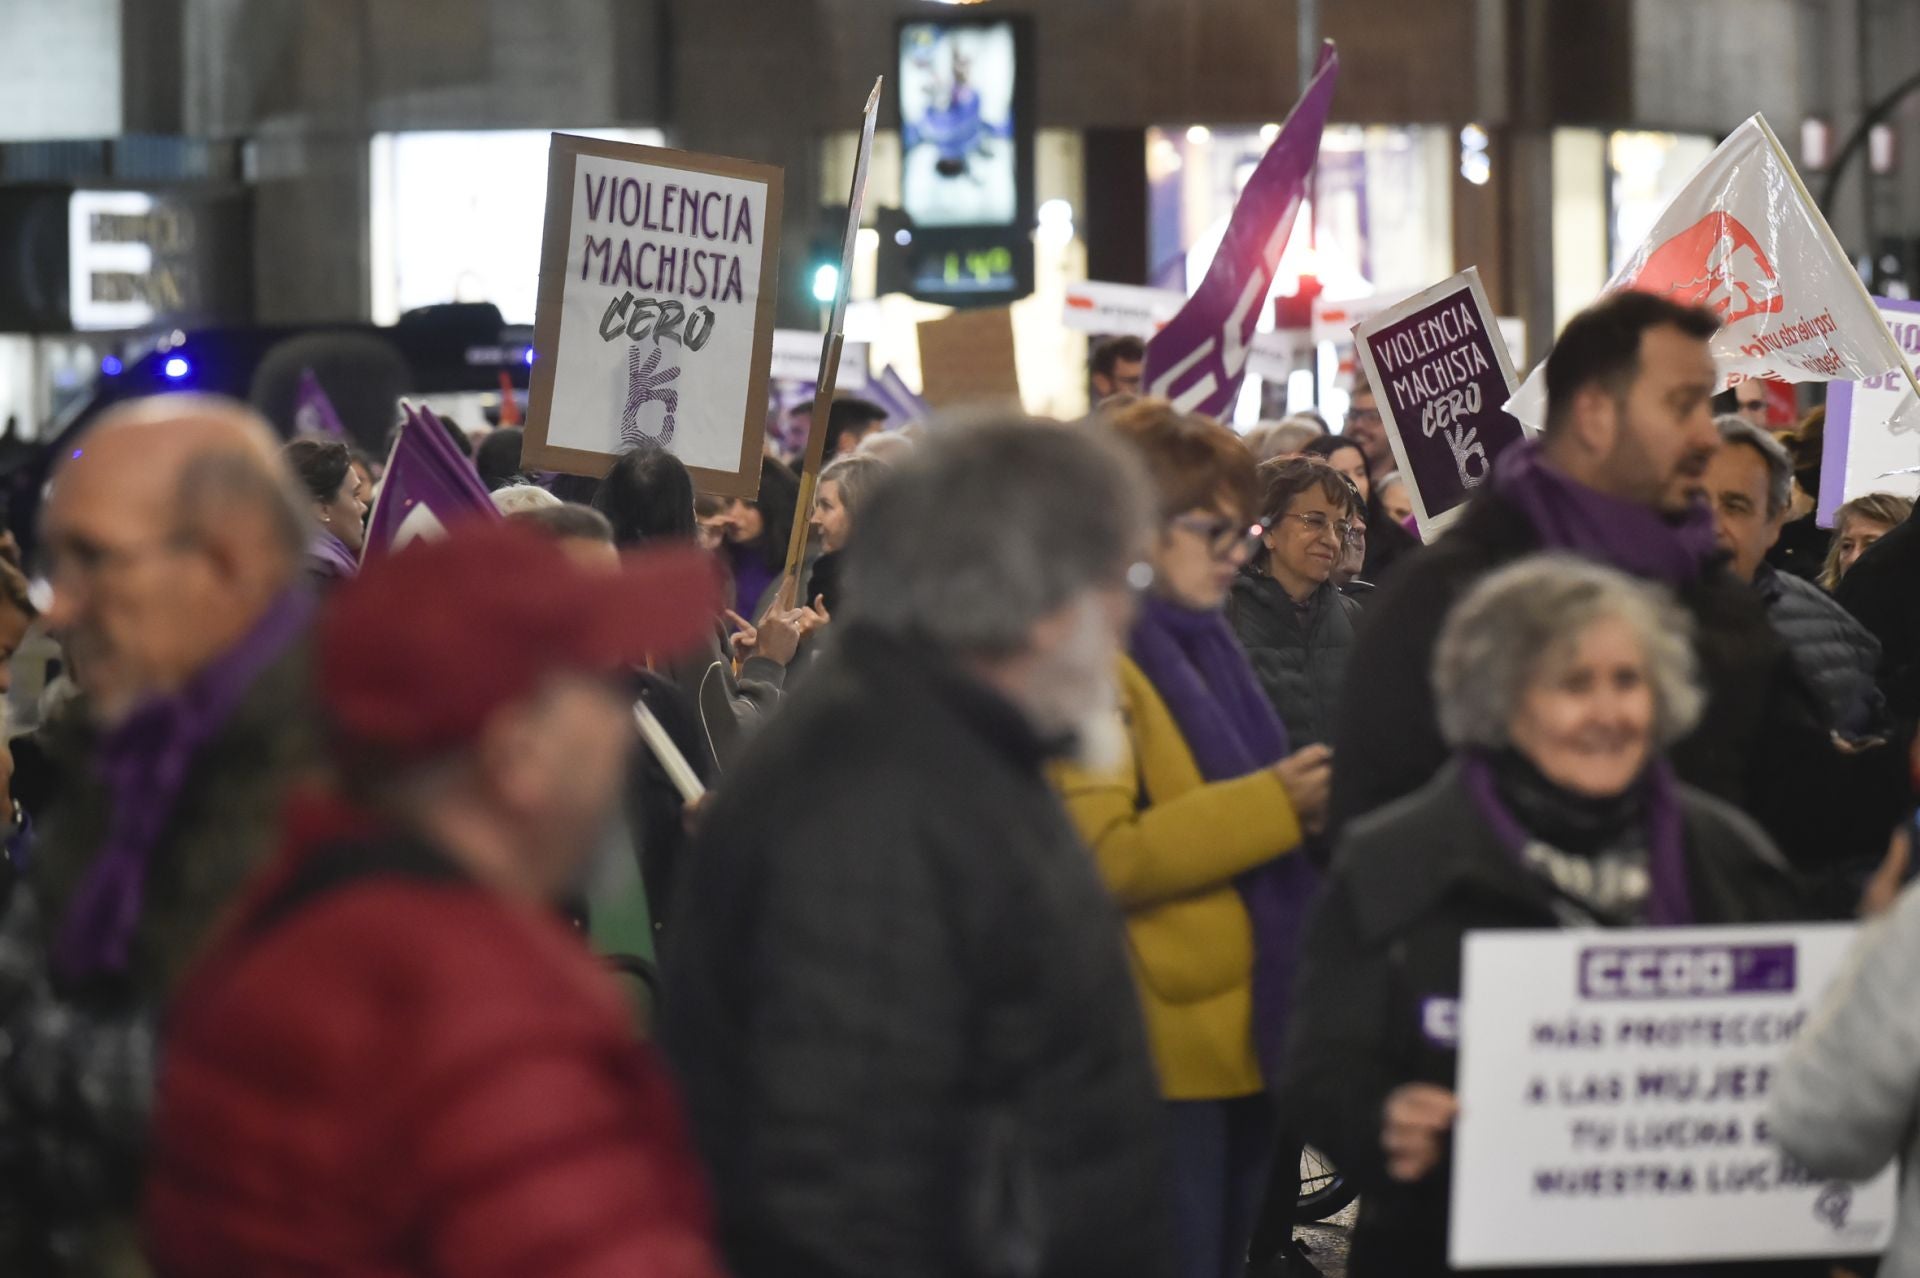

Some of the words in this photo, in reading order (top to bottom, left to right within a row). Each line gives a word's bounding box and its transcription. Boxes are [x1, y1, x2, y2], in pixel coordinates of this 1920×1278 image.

[585, 173, 753, 245] VIOLENCIA
[577, 234, 743, 304] MACHISTA
[599, 290, 716, 352] CERO
[1376, 302, 1479, 373] VIOLENCIA
[1392, 342, 1490, 410] MACHISTA
[1422, 381, 1482, 438] CERO
[1586, 950, 1735, 995] CCOO
[1526, 1076, 1547, 1102] A
[1559, 1074, 1623, 1102] LAS
[1572, 1119, 1615, 1149] TU
[1624, 1116, 1742, 1148] LUCHA
[1533, 1163, 1695, 1195] NUESTRA
